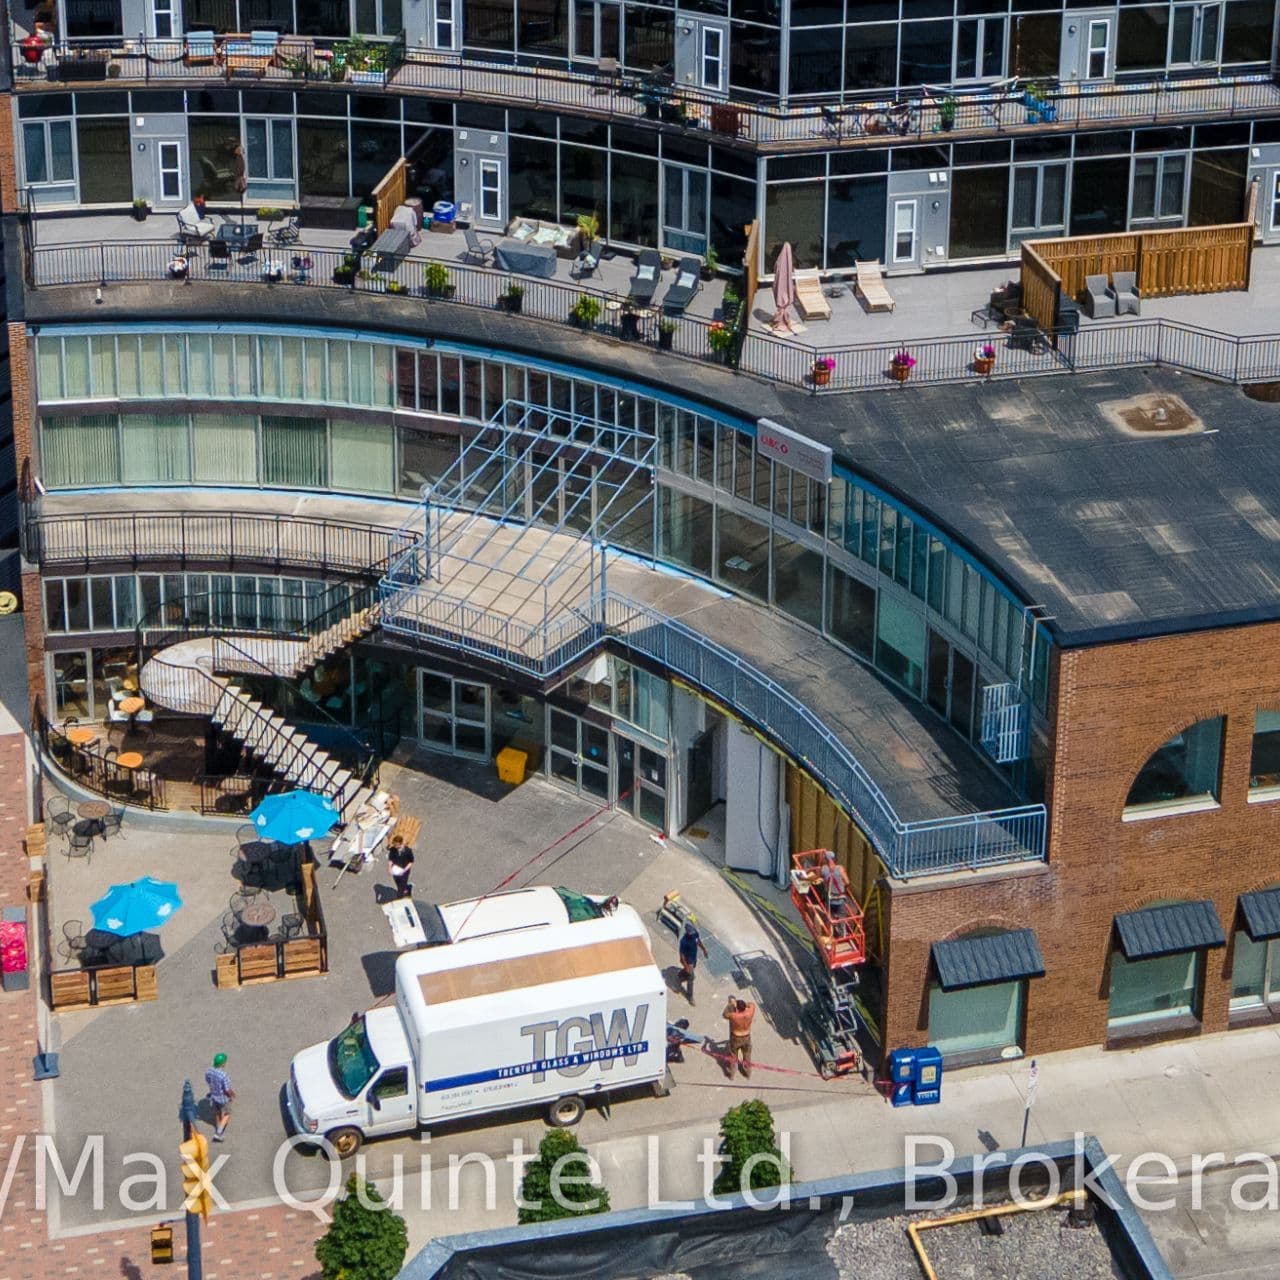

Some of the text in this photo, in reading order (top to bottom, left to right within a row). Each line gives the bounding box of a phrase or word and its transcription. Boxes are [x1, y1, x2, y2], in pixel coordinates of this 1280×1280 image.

[498, 1061, 538, 1078] TRENTON
[541, 1055, 569, 1070] GLASS
[582, 1047, 625, 1063] WINDOWS
[520, 1003, 649, 1084] TGW
